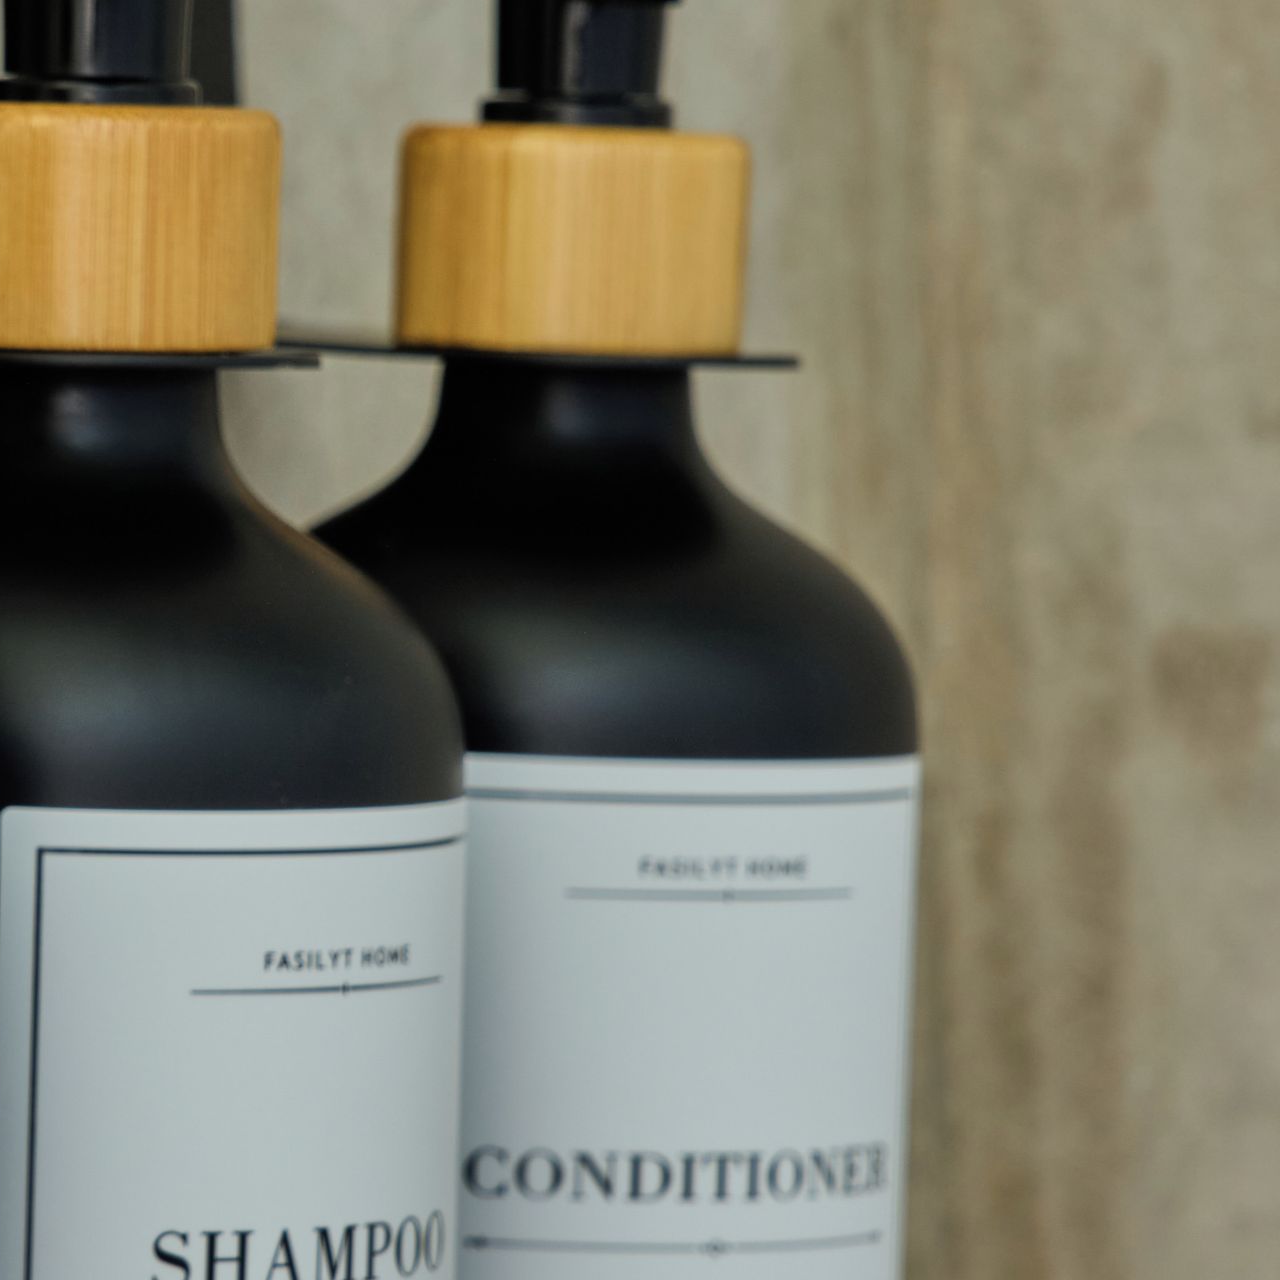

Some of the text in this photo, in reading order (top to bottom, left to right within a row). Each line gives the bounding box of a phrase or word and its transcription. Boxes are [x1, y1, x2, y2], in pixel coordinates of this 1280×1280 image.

[264, 944, 411, 972] FASILYT HOME
[462, 1141, 887, 1203] CONDITIONER
